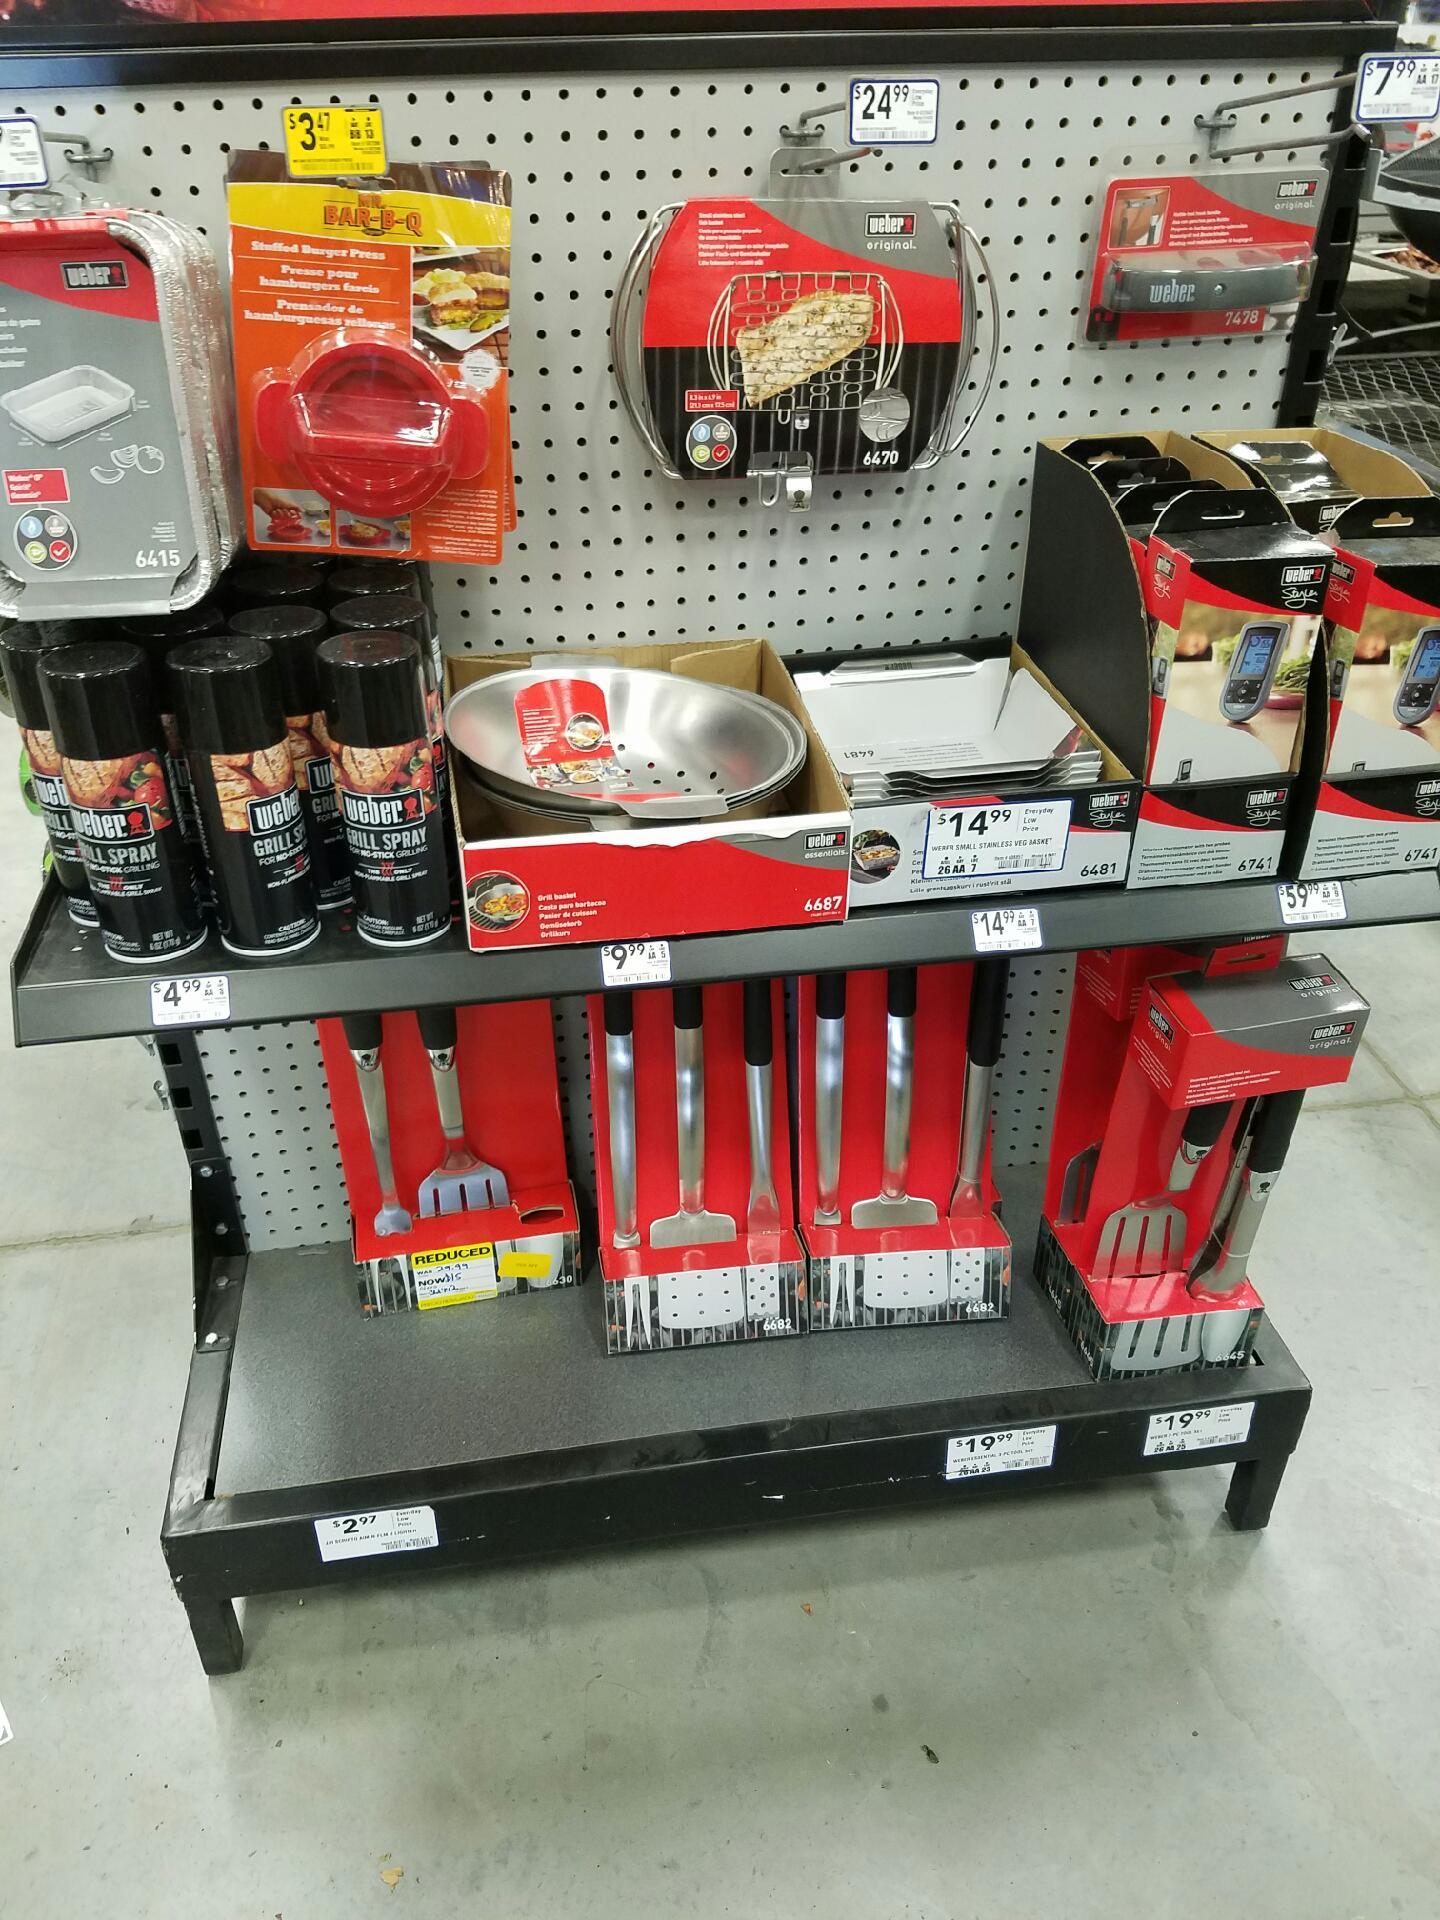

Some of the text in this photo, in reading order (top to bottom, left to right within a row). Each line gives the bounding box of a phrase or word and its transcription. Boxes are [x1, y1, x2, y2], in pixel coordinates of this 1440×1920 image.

[1279, 181, 1309, 197] weber
[1275, 200, 1315, 211] original
[323, 205, 423, 237] BAR-B-Q
[869, 214, 904, 234] weber
[251, 240, 386, 261] Stuffed Burger Press
[866, 239, 915, 252] original
[65, 263, 111, 287] weber
[280, 264, 359, 280] Presse pour
[259, 275, 380, 295] hamburgers farcis
[1149, 278, 1195, 304] weber
[347, 303, 364, 315] de
[244, 309, 343, 327] hamburguesas
[1225, 310, 1259, 327] 7478
[862, 450, 900, 466] 6470
[135, 549, 181, 568] 6415
[1285, 566, 1314, 583] weber
[36, 779, 71, 807] web
[1419, 780, 1440, 794] webe
[1091, 794, 1120, 808] weber
[1249, 790, 1277, 806] weber
[345, 795, 403, 826] weber
[1025, 807, 1055, 816] Everyday
[1416, 797, 1440, 816] Styl
[1024, 816, 1037, 824] Low
[253, 831, 295, 857] GRILL
[382, 826, 427, 850] SPRAY
[808, 832, 836, 849] weber
[955, 842, 977, 851] SMALL
[978, 840, 1013, 850] STAINLESS
[1014, 838, 1027, 847] VEG
[1028, 837, 1053, 846] BASKET
[107, 841, 158, 866] SPRAY
[360, 844, 429, 860] NO-STICK GRILLING
[804, 848, 849, 859] essentials
[1404, 847, 1438, 862] 6741
[123, 861, 161, 874] GRILLING
[259, 856, 276, 866] FOR
[1237, 856, 1273, 873] 6741
[938, 865, 951, 875] 26
[952, 864, 966, 874] AA
[1080, 862, 1117, 878] 6481
[538, 892, 577, 902] Grill basket
[538, 899, 607, 911] Cesta para barbacoa
[804, 895, 843, 912] 6687
[562, 910, 571, 918] de
[1292, 975, 1324, 991] weber
[1299, 985, 1342, 999] original
[1313, 1024, 1346, 1040] weber
[1308, 1036, 1352, 1050] original
[414, 1246, 491, 1265] REDUCED
[418, 1278, 446, 1287] NOW
[965, 1302, 994, 1314] 6682
[763, 1318, 792, 1331] 6682
[1214, 1350, 1246, 1363] 6645
